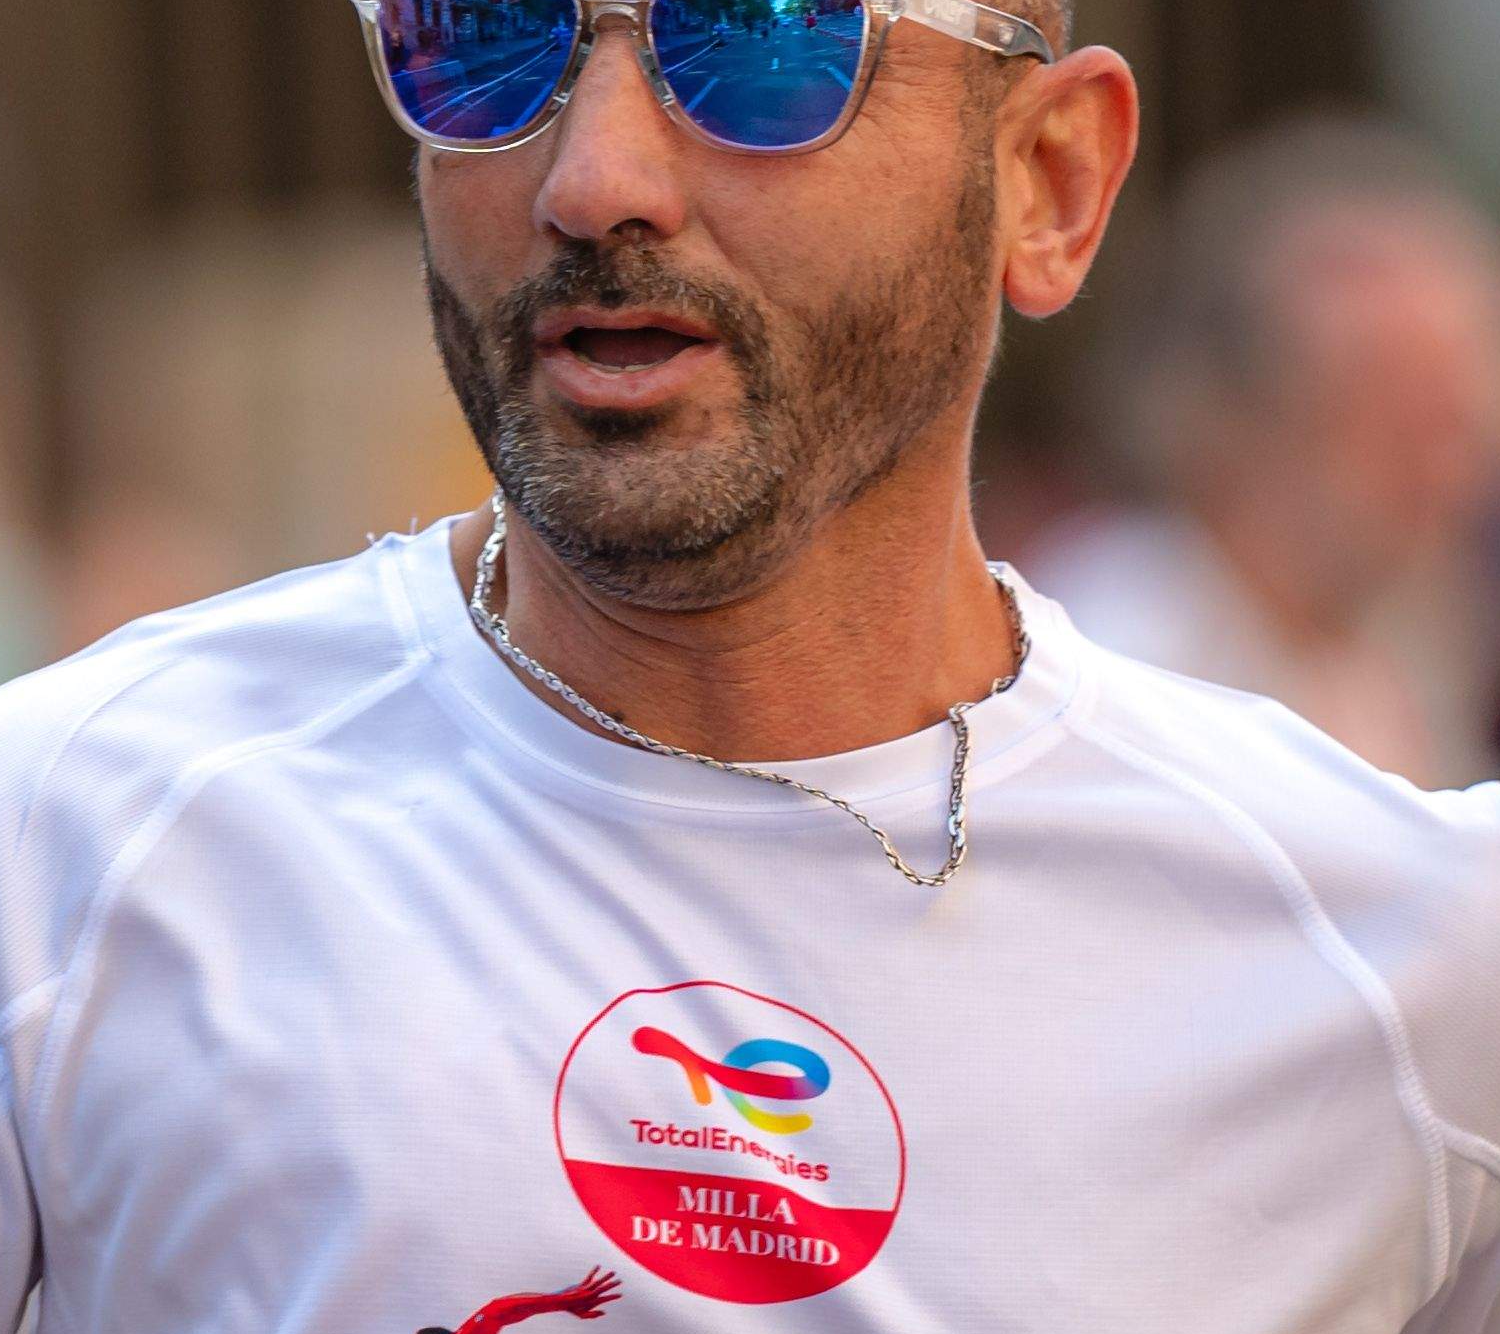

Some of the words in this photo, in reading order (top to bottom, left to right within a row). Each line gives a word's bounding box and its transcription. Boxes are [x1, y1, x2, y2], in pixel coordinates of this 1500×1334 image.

[629, 1118, 830, 1182] TotalEnergies
[676, 1184, 798, 1226] MILLA
[630, 1215, 684, 1247] DE
[690, 1222, 841, 1268] MADRID
